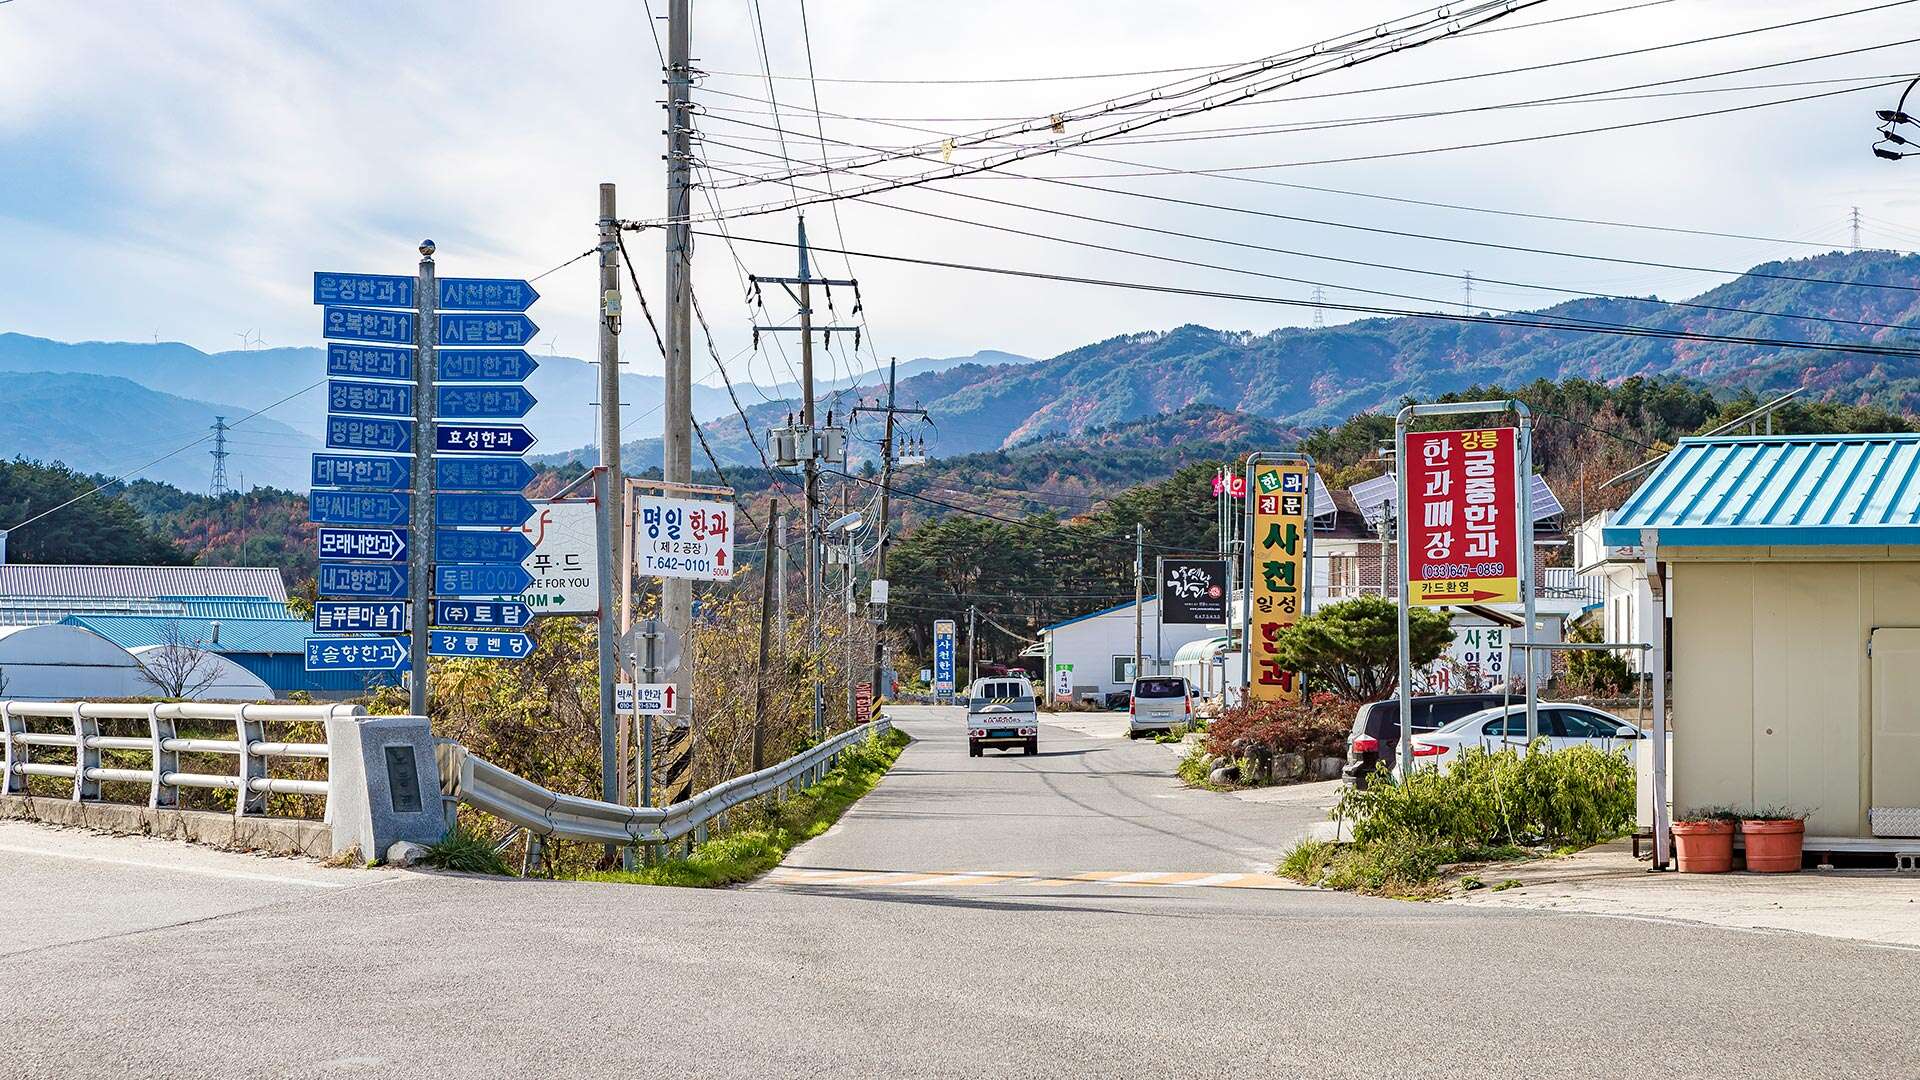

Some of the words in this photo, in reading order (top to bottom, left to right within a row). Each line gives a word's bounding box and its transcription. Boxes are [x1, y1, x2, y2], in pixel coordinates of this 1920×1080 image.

[320, 278, 395, 301] 은정한과
[445, 283, 522, 306] 사천한과
[328, 312, 397, 337] 오복한과
[445, 319, 523, 342] 시골한과
[331, 349, 396, 374] 고원한과
[444, 355, 521, 377] 선미한과
[444, 391, 521, 413] 수정한과
[333, 421, 396, 446] 명일한과
[448, 430, 513, 449] 효성한과
[1461, 430, 1499, 450] 강릉
[317, 460, 392, 483] 대박한과
[1258, 470, 1302, 494] 한과
[315, 495, 392, 519] 박씨네한과
[1258, 496, 1302, 516] 전문
[1422, 438, 1456, 560] 한과매장
[1464, 450, 1500, 558] 궁중한과
[689, 509, 729, 543] 한과
[321, 535, 395, 556] 모래내한과
[646, 556, 710, 573] T.642-0101
[1262, 523, 1300, 594] 사천
[323, 568, 392, 593] 내고향한과
[713, 567, 730, 577] 500M
[1421, 562, 1505, 580] (033)647-0859
[546, 578, 566, 588] FOR
[567, 578, 590, 587] YOU
[444, 607, 469, 622] (주)
[1256, 595, 1296, 613] 일성
[318, 607, 387, 628] 늘푸른마을
[1464, 629, 1503, 650] 사천
[322, 644, 398, 664] 솔향한과
[938, 639, 951, 681] 사천한과
